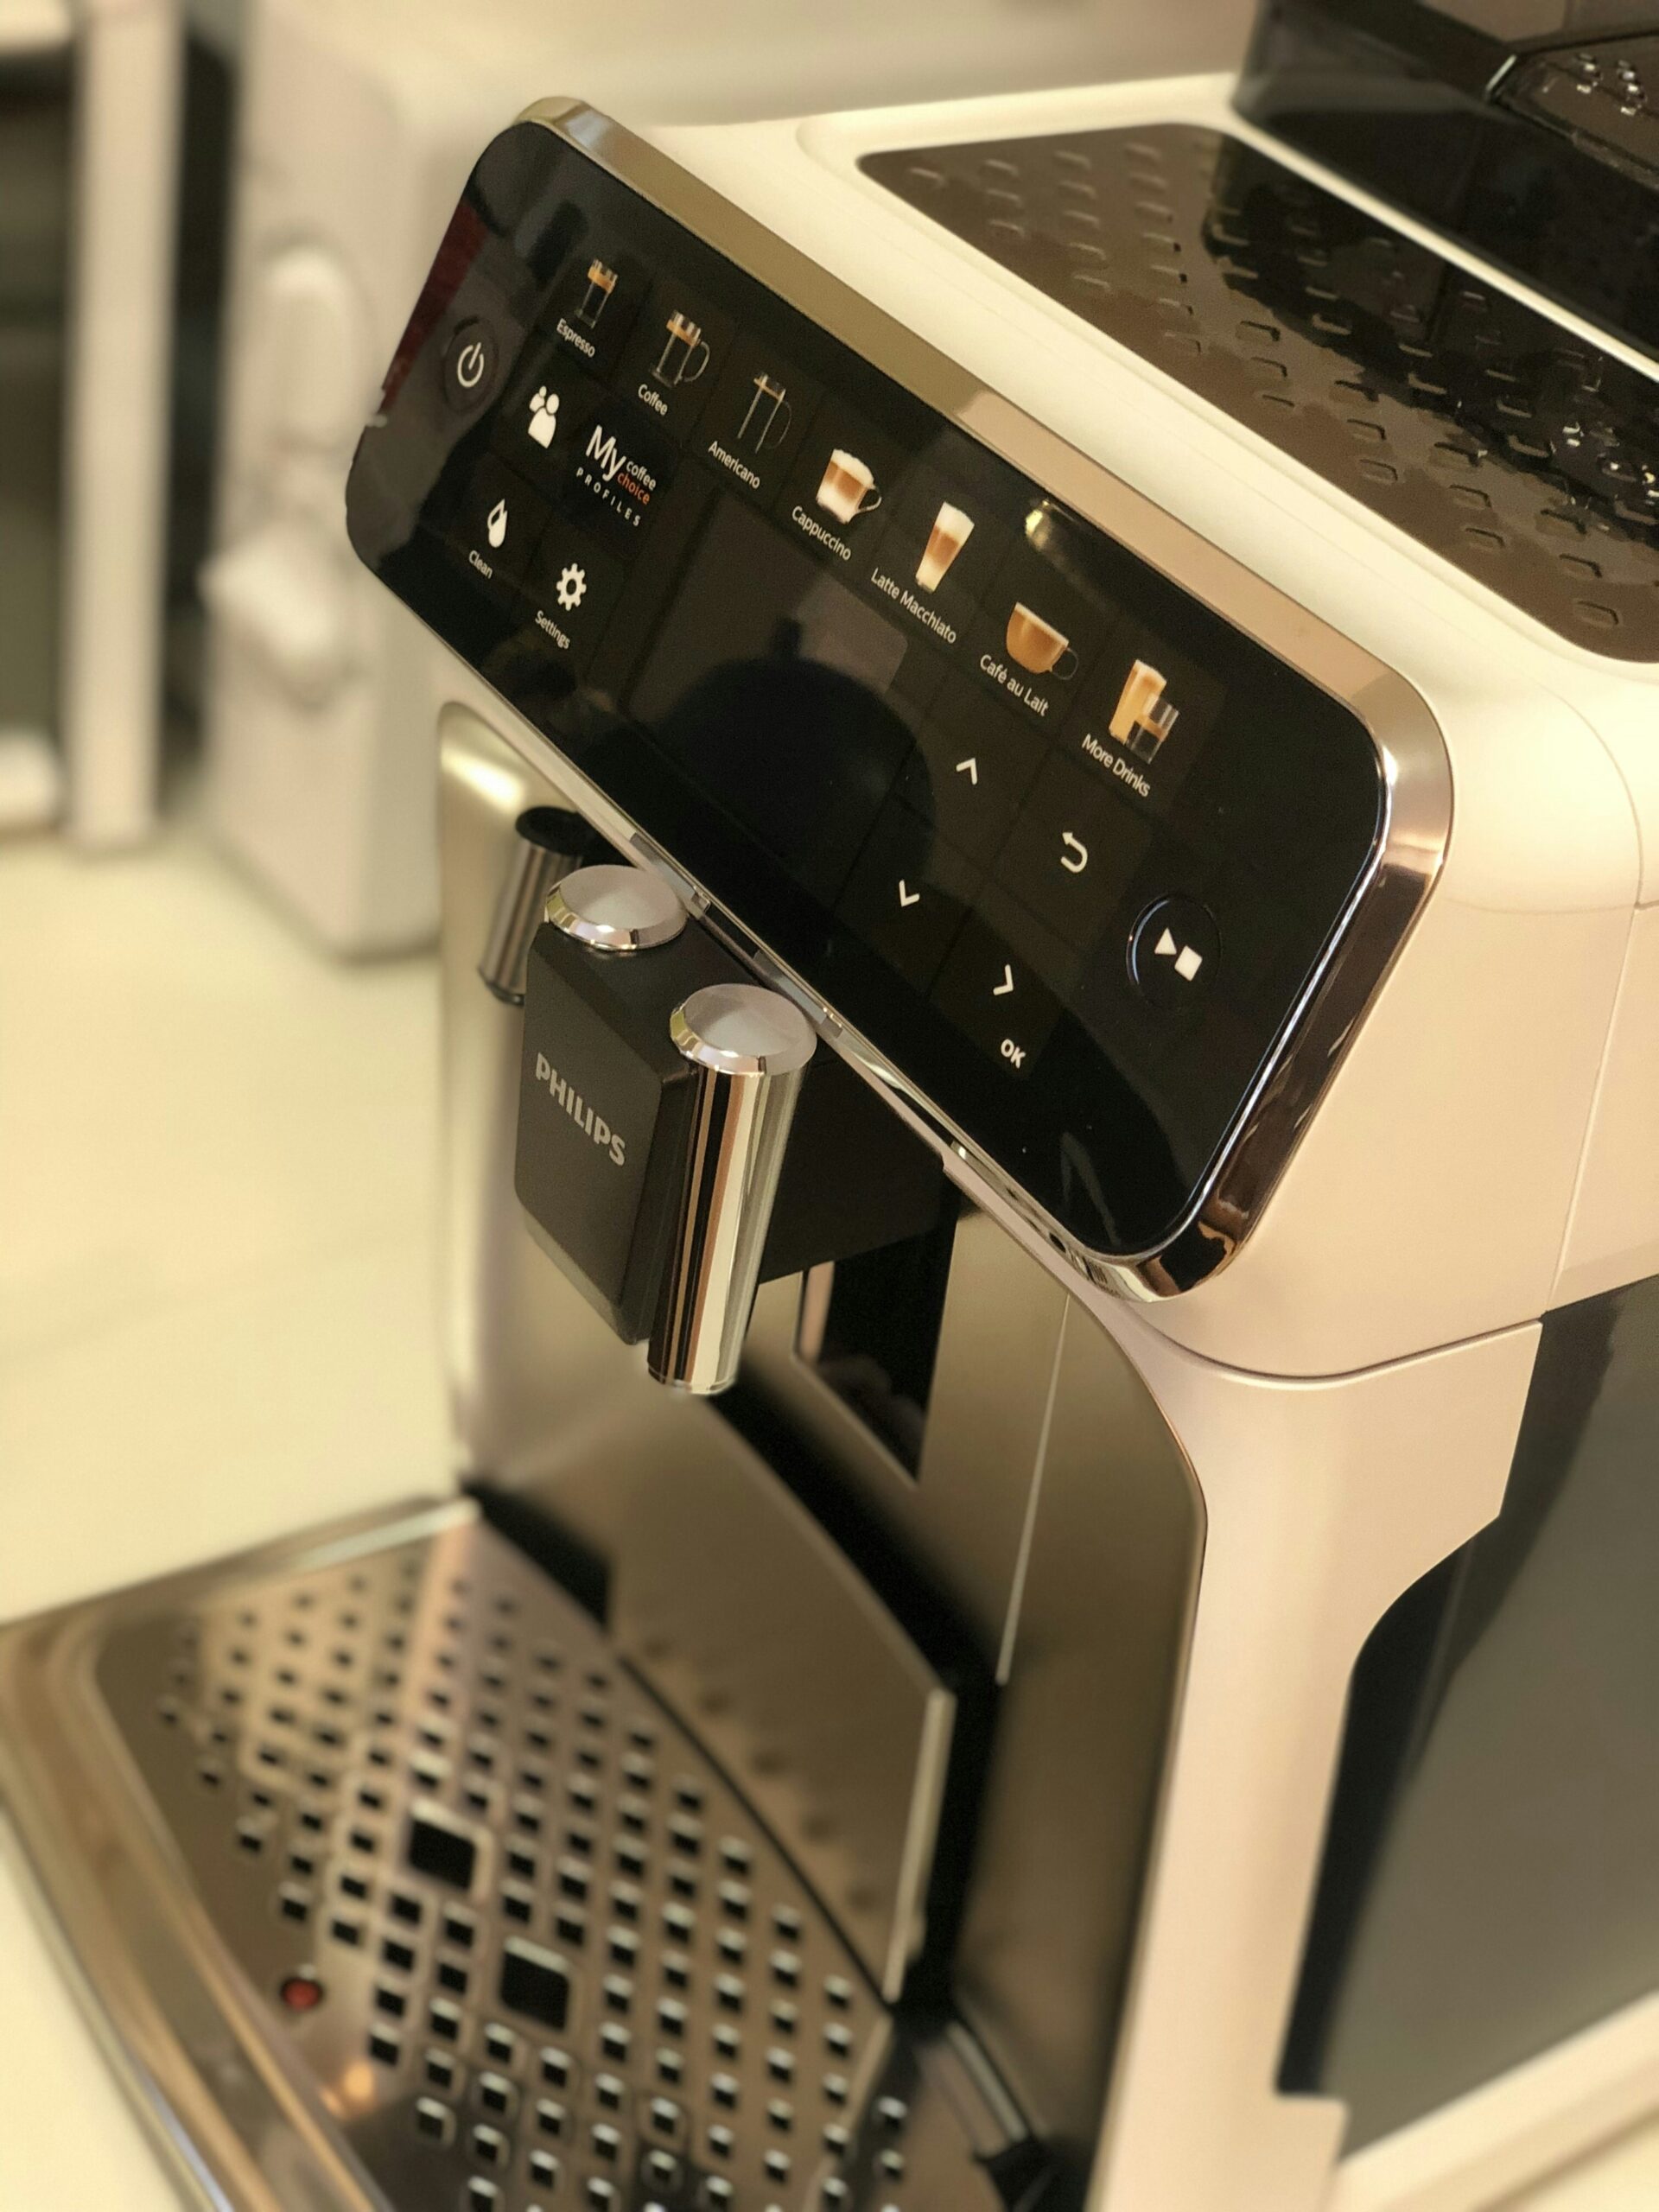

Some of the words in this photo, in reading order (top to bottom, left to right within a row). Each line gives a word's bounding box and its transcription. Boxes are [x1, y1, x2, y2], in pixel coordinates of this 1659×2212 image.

[556, 318, 595, 358] Espresso
[638, 384, 668, 416] Coffee
[585, 424, 626, 481] My
[626, 461, 657, 491] coffee
[708, 441, 760, 489] Americano
[576, 467, 641, 526] PROFILES
[617, 473, 651, 505] choice
[791, 505, 851, 561] Cappuccino
[468, 550, 493, 579] Clean
[535, 610, 571, 649] Settings
[871, 568, 899, 600] Latte
[900, 590, 957, 644] Macchiato
[980, 654, 1007, 685] Café
[1007, 677, 1024, 697] au
[1024, 687, 1049, 716] Lait
[1082, 734, 1114, 767] More
[1112, 758, 1151, 798] Drinks
[1001, 1039, 1026, 1068] OK
[536, 1052, 626, 1166] PHILIPS
